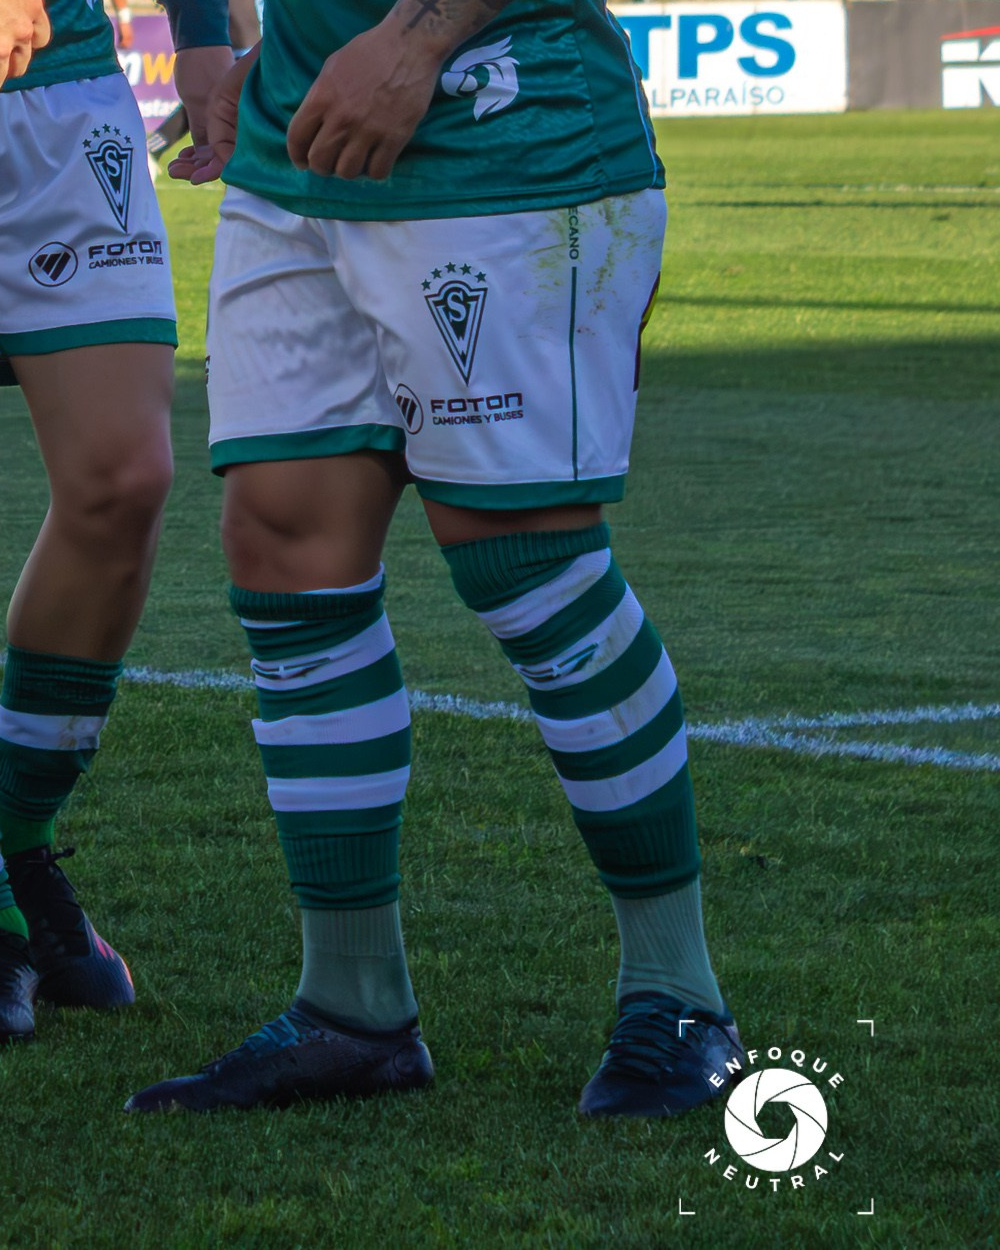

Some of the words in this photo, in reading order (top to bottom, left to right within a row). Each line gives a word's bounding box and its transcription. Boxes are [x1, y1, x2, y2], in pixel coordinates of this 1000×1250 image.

[619, 12, 796, 80] TPS
[651, 85, 785, 109] LPARAÍSO
[88, 241, 162, 259] FOTON
[89, 257, 137, 269] CAMIONES
[430, 393, 523, 413] FOTON
[432, 415, 482, 425] CAMIONES
[484, 414, 492, 423] Y
[494, 410, 524, 422] BUSES
